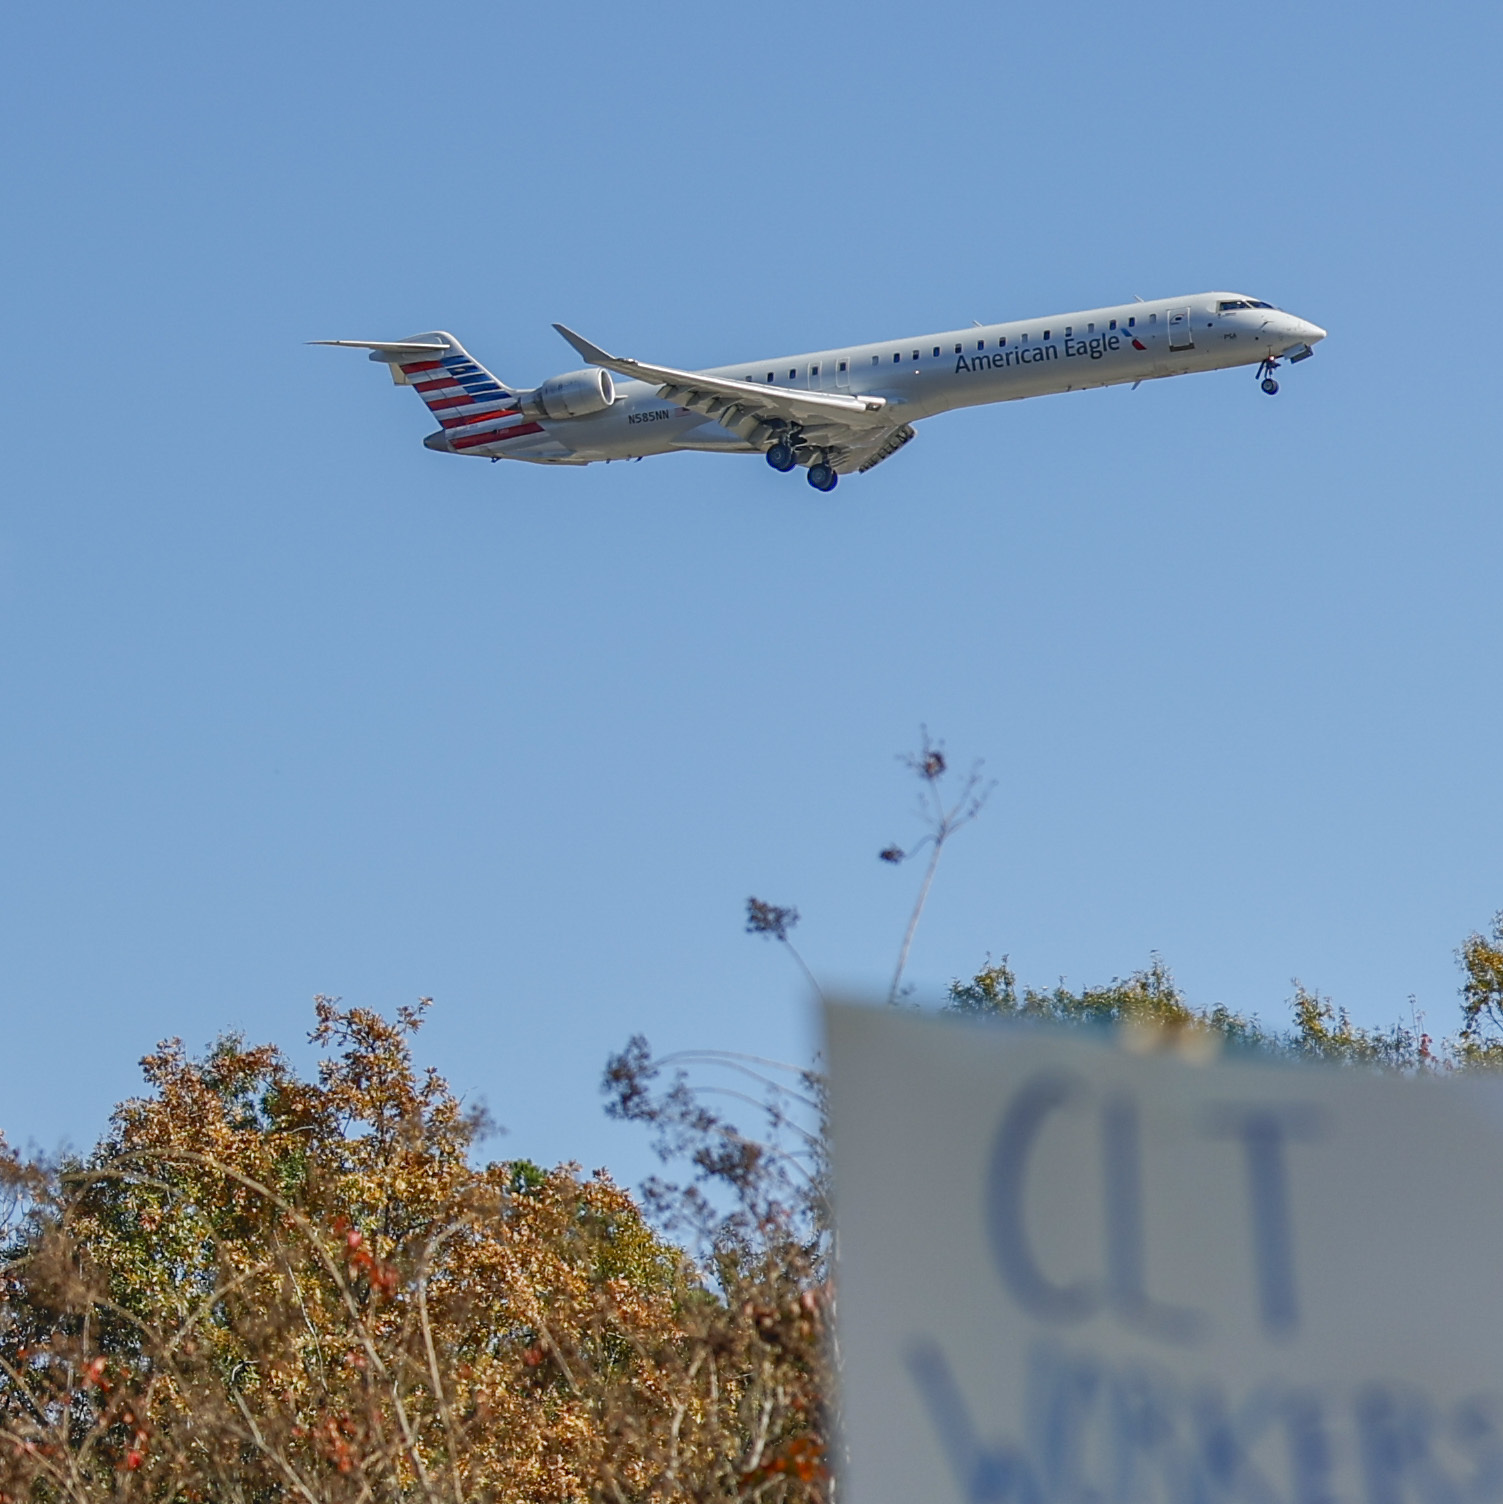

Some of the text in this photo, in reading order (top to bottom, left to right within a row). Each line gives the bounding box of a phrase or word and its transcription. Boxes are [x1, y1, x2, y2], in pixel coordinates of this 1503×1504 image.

[955, 332, 1121, 374] American Eagle
[628, 409, 670, 425] N585NN
[984, 1065, 1334, 1345] CLT
